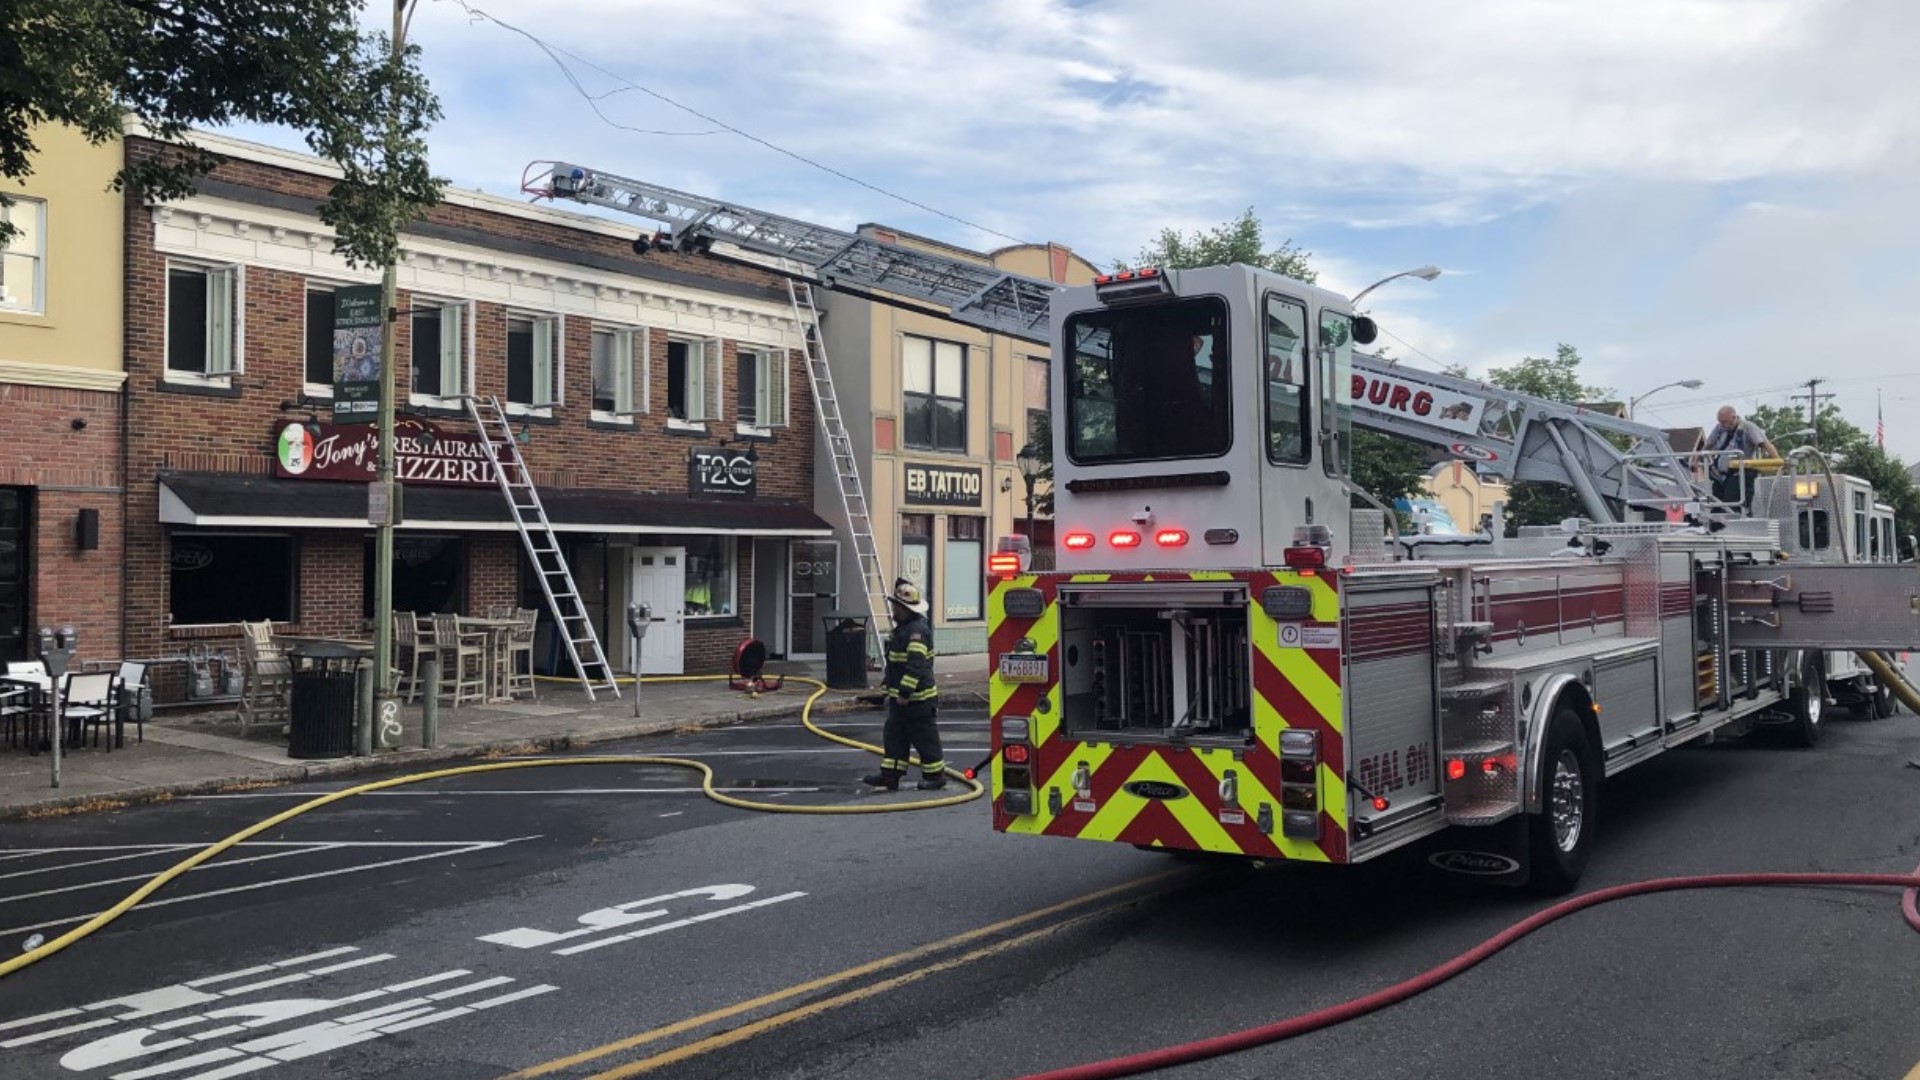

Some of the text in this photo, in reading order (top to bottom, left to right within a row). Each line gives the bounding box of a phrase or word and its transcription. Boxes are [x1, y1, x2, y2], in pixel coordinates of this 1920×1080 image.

[314, 433, 379, 469] Tony's
[366, 455, 497, 483] & IZZERI
[696, 454, 752, 486] T2C
[907, 468, 980, 495] EB TATTOO
